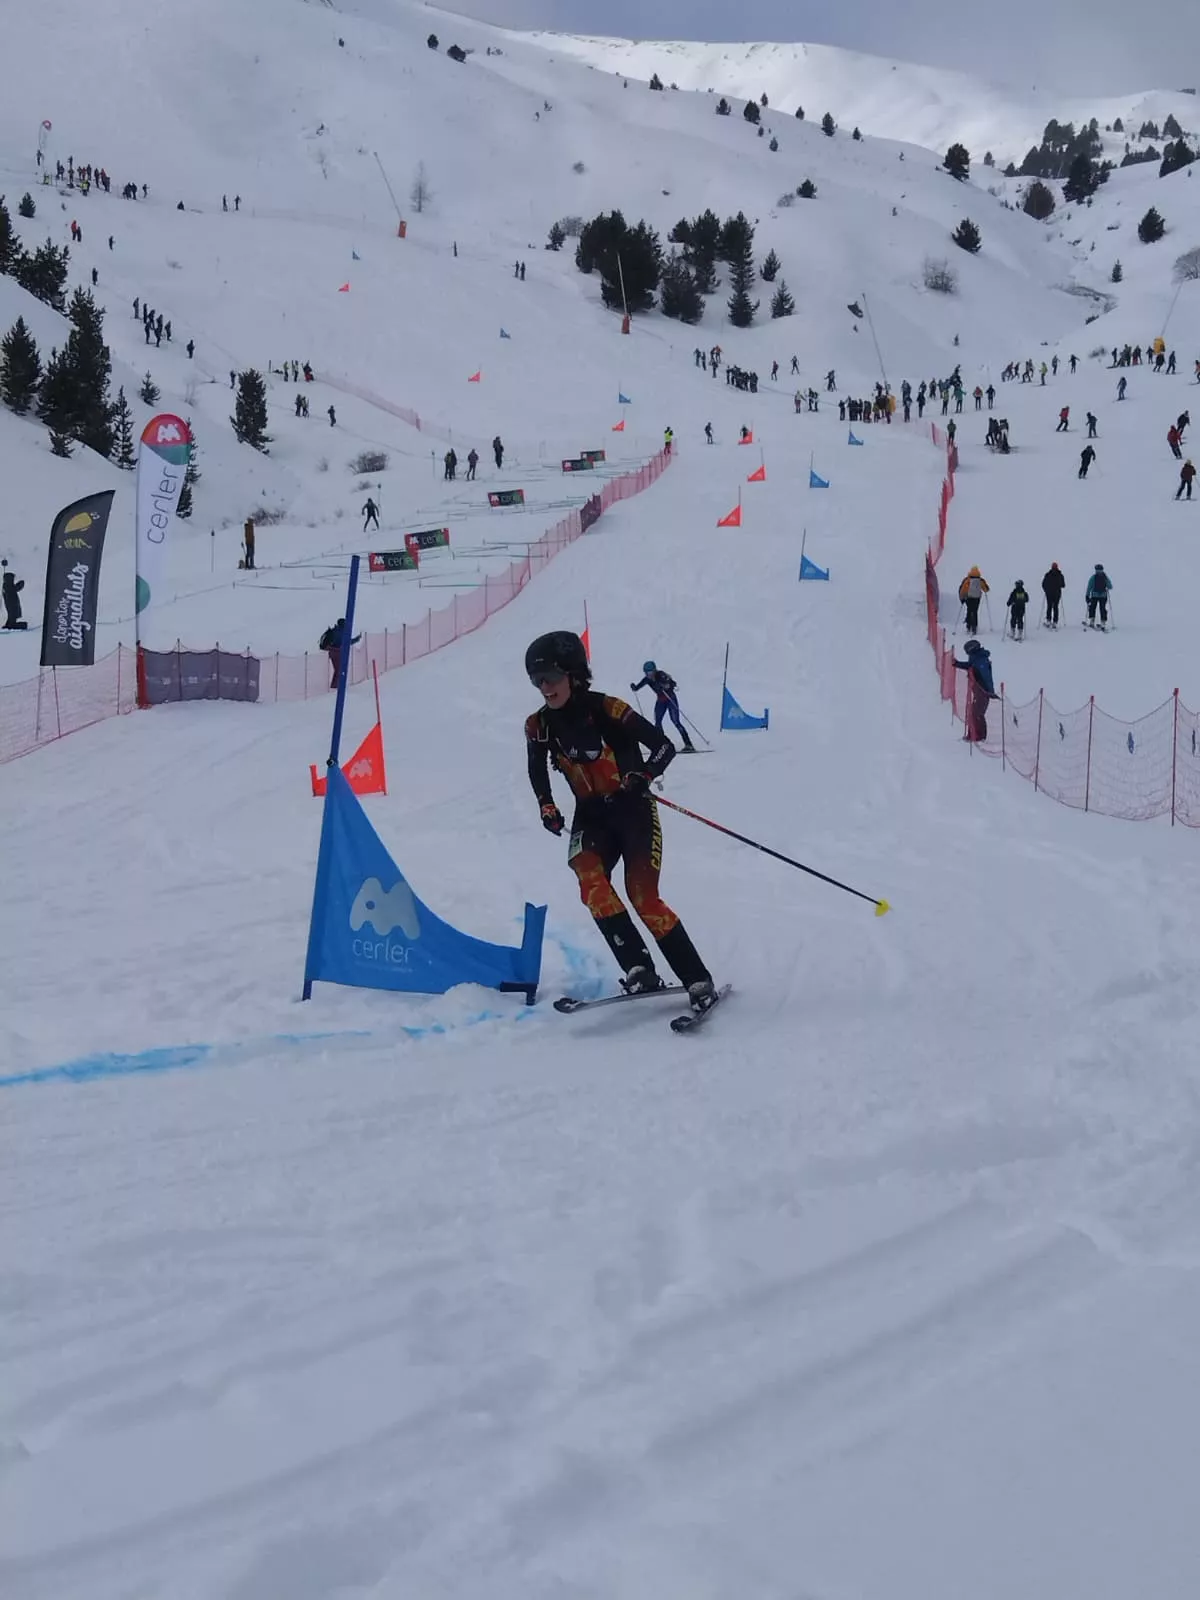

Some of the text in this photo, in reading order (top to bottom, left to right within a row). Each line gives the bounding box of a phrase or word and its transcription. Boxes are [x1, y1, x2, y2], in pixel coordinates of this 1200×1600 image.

[147, 466, 179, 544] cerler
[65, 562, 90, 649] aigualluts
[352, 937, 414, 963] cerler
